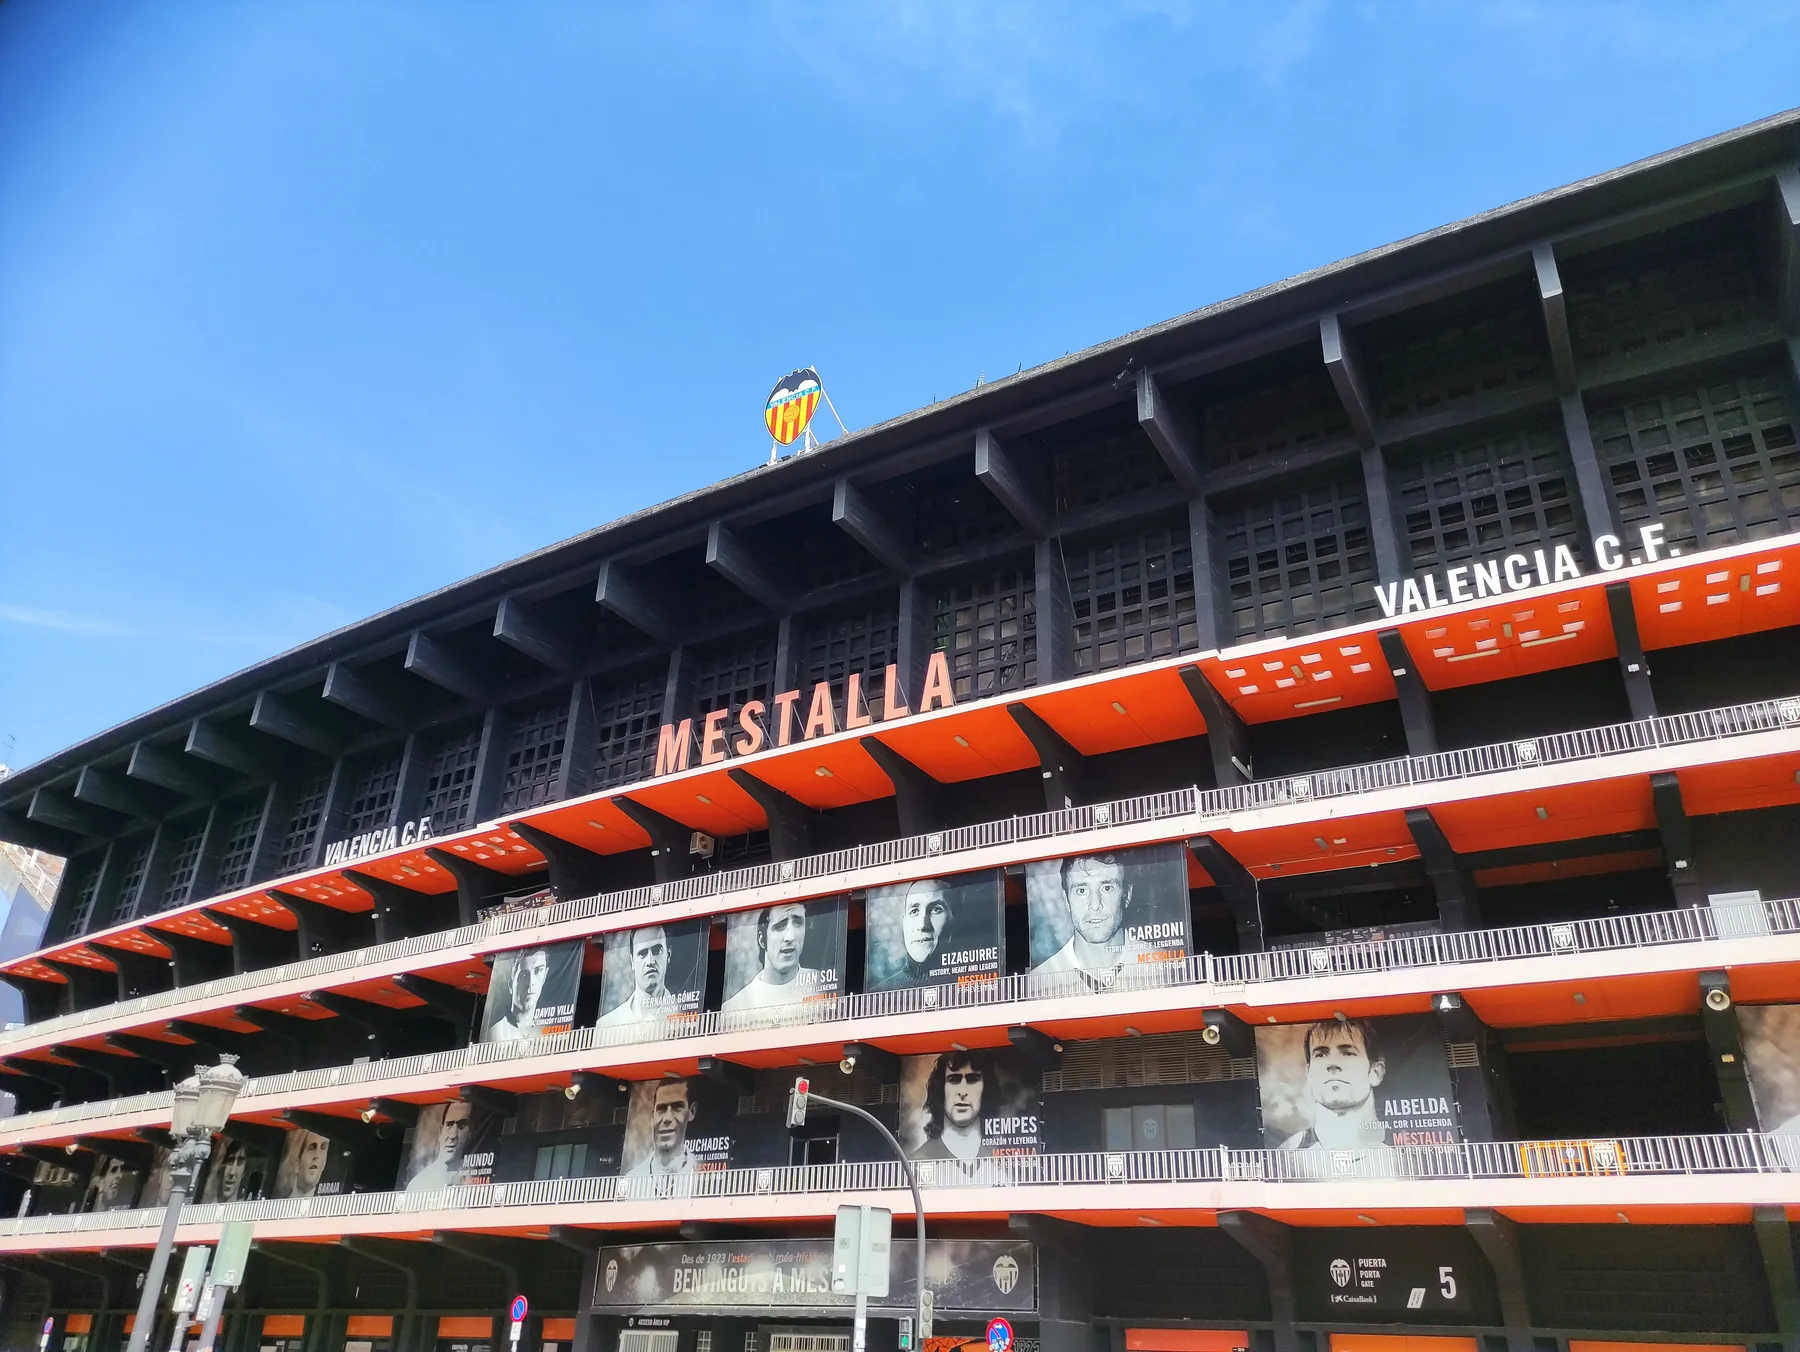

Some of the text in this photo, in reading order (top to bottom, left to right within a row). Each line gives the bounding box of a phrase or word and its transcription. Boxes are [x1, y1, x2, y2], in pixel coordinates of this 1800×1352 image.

[1373, 522, 1682, 618] VALENCIA C.F.
[654, 651, 955, 777] MESTALLA
[324, 816, 431, 867] VALENCIA C.F.
[1128, 921, 1184, 941] CARBONI
[1154, 939, 1184, 949] LEGGENDA
[941, 946, 998, 966] EIZAGUIRRE
[952, 965, 967, 974] HEART
[968, 964, 978, 972] AND
[979, 962, 998, 971] LEGEND
[795, 968, 838, 987] JUAN SOL
[677, 990, 700, 1004] GÓMEZ
[534, 1003, 574, 1019] DAVID VILLA
[1384, 1097, 1450, 1117] ALBELDA
[984, 1115, 1038, 1135] KEMPES
[1393, 1119, 1408, 1129] COR
[1415, 1118, 1452, 1128] LLEGENDA
[982, 1136, 1007, 1146] CORAZÓN
[1013, 1136, 1038, 1145] LEYENDA
[1392, 1130, 1454, 1146] MESTALLA
[462, 1151, 495, 1168] MUNDO
[681, 1253, 695, 1264] Des
[696, 1253, 705, 1264] de
[707, 1253, 726, 1264] 1923
[1358, 1258, 1387, 1268] PUERTA
[773, 1267, 784, 1293] A
[1359, 1270, 1381, 1279] PORTA
[1439, 1266, 1457, 1299] 5
[1361, 1280, 1375, 1288] GATE
